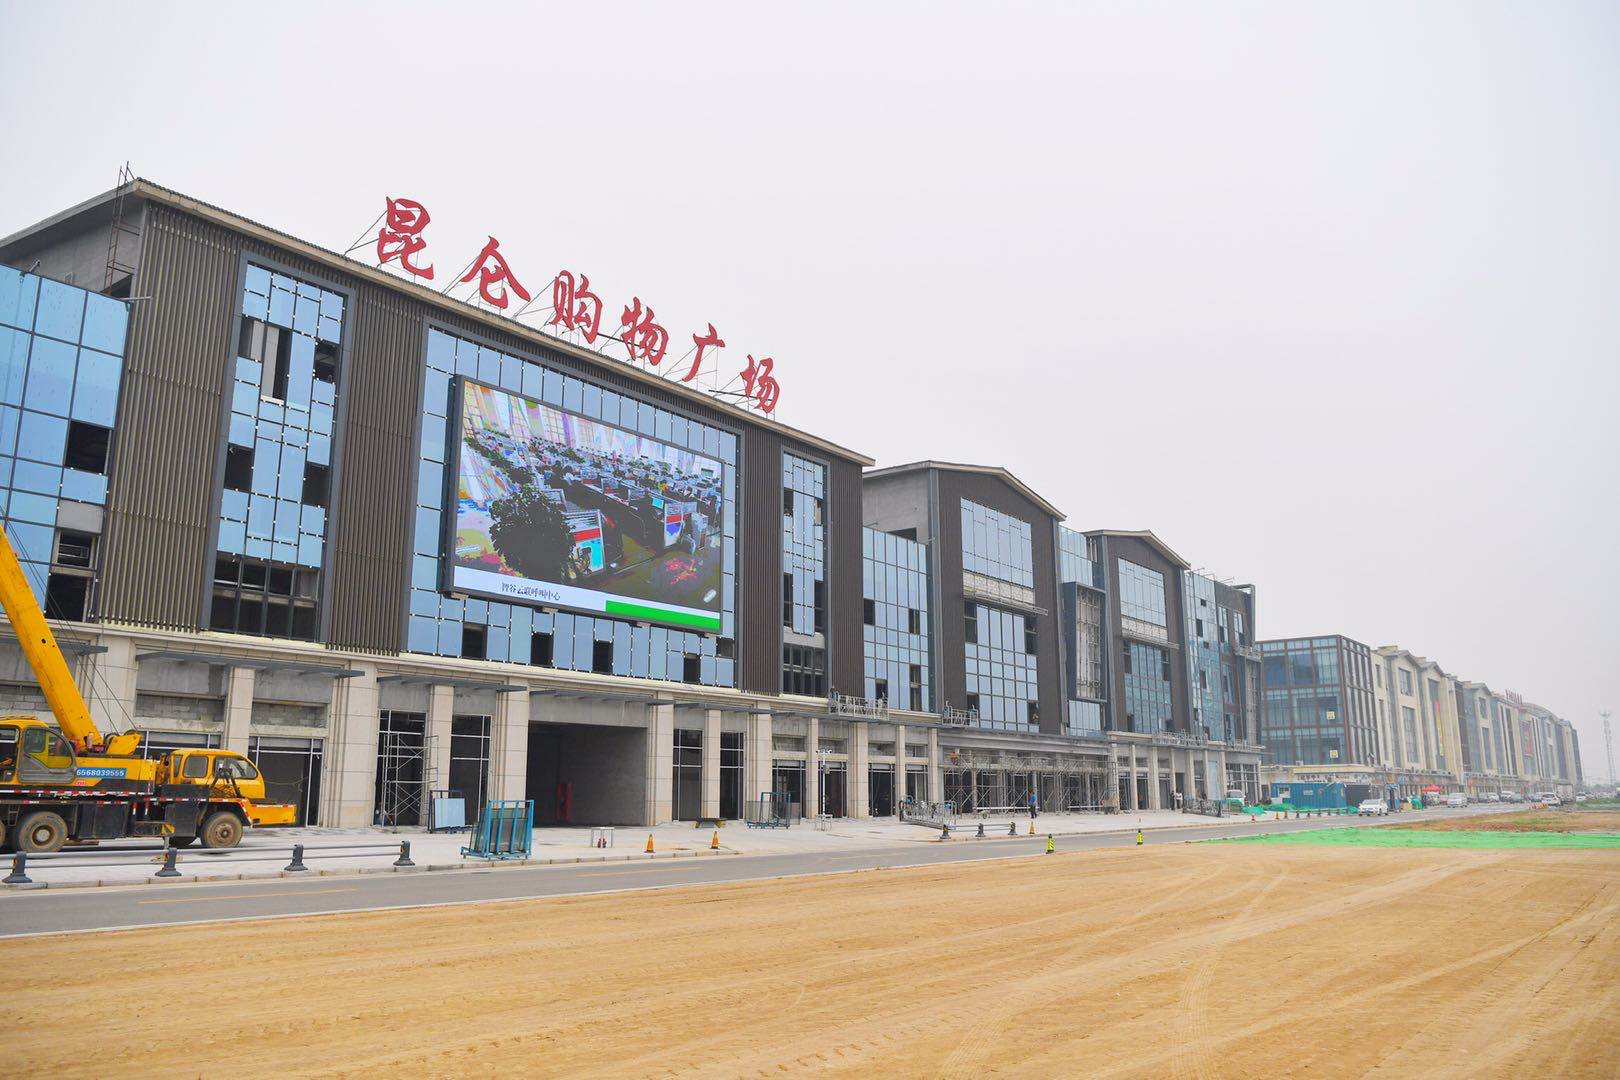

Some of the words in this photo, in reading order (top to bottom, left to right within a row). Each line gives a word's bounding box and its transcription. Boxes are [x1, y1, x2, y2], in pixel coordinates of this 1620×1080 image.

[377, 196, 780, 414] 昆仑购物广场
